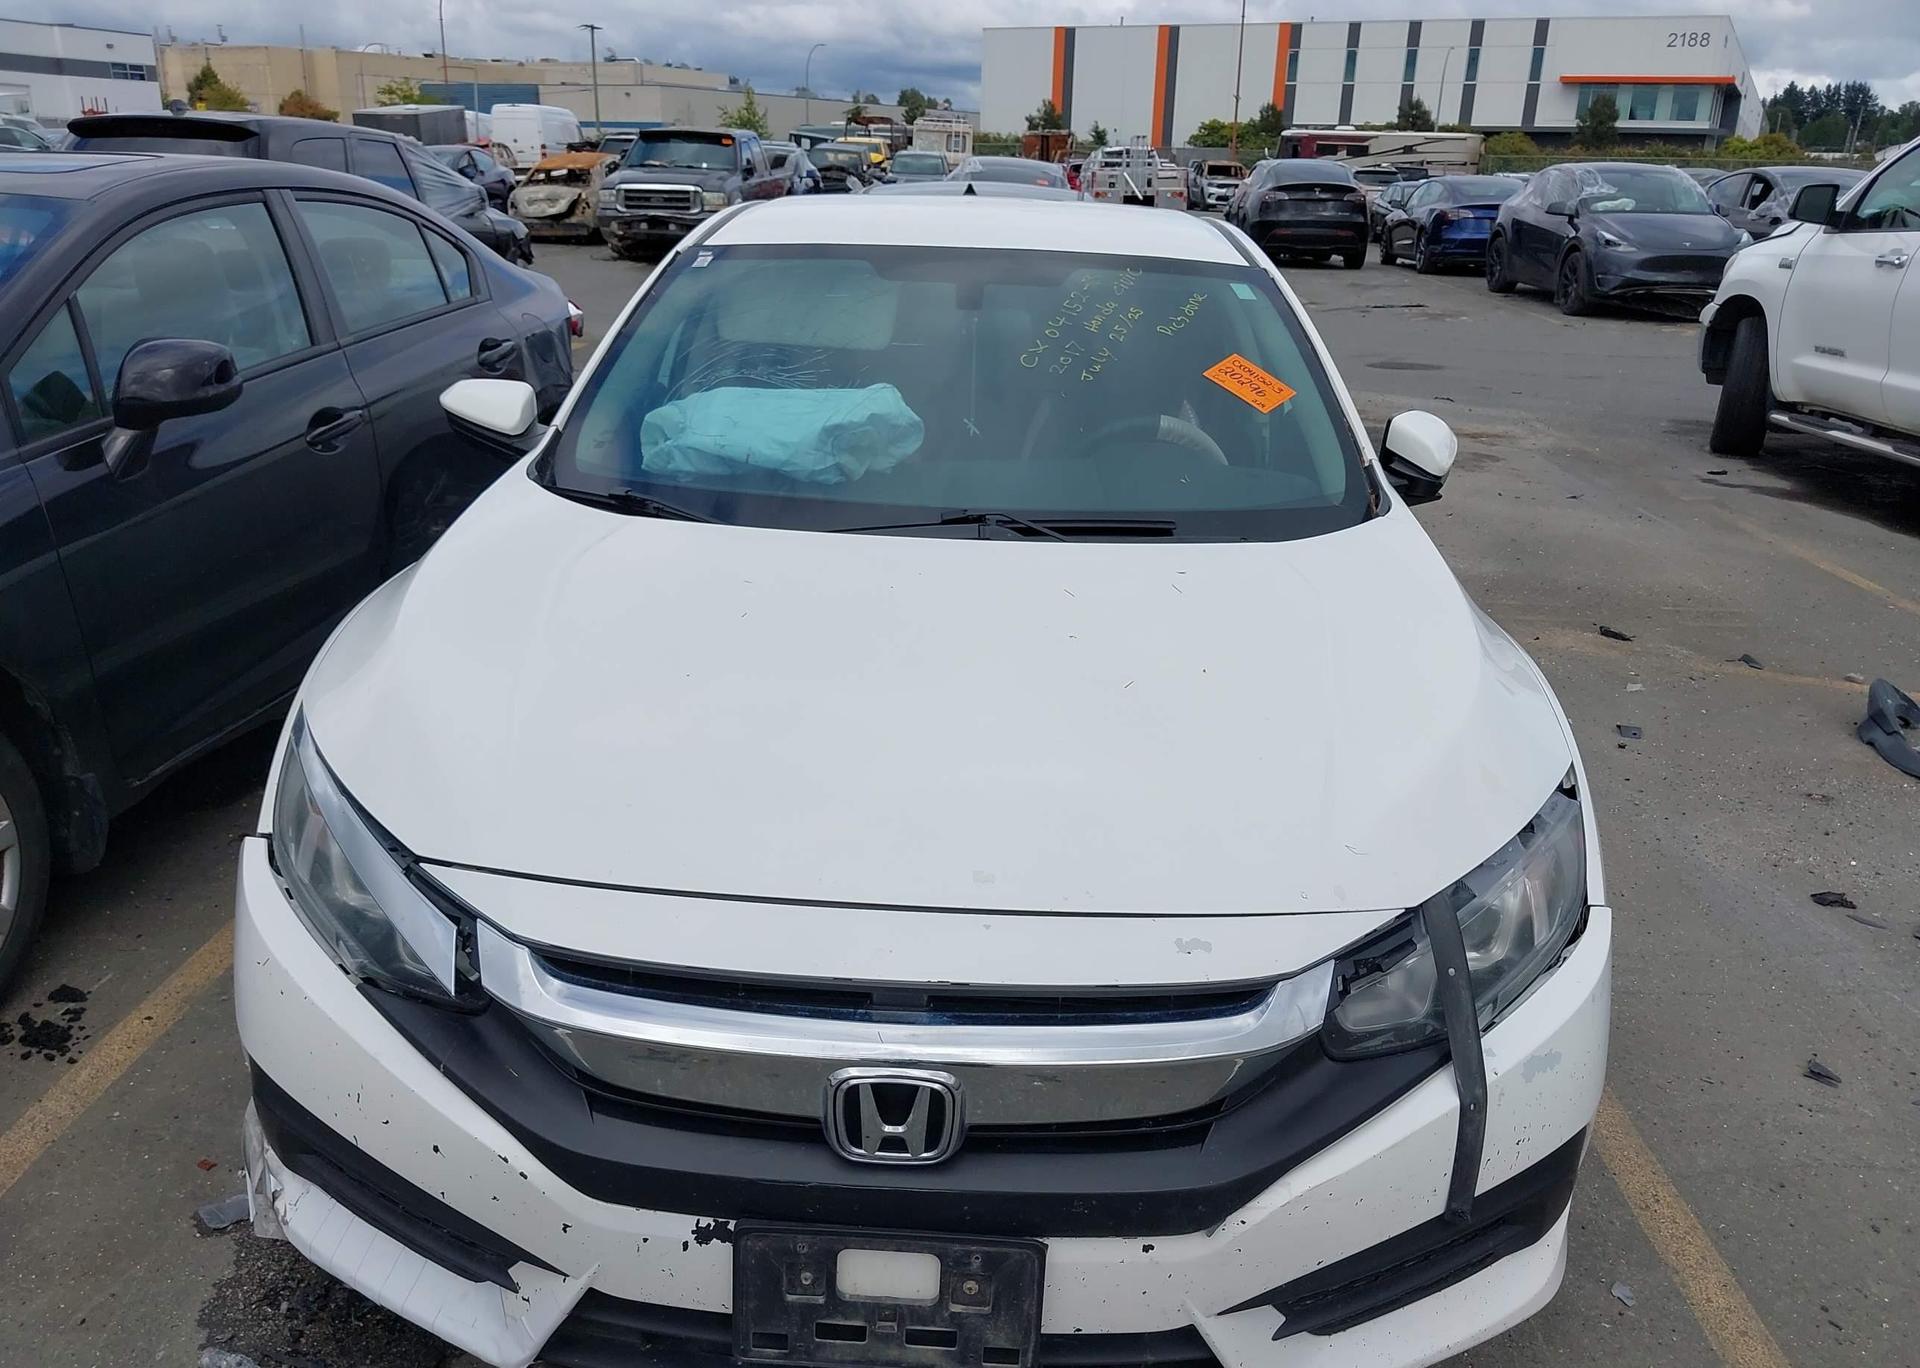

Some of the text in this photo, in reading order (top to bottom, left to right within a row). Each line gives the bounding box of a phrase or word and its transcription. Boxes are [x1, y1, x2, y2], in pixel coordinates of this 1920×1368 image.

[1666, 32, 1711, 48] 2188
[1049, 341, 1085, 374] 2017
[1083, 301, 1118, 333] Honda
[1081, 306, 1144, 381] July 25/25
